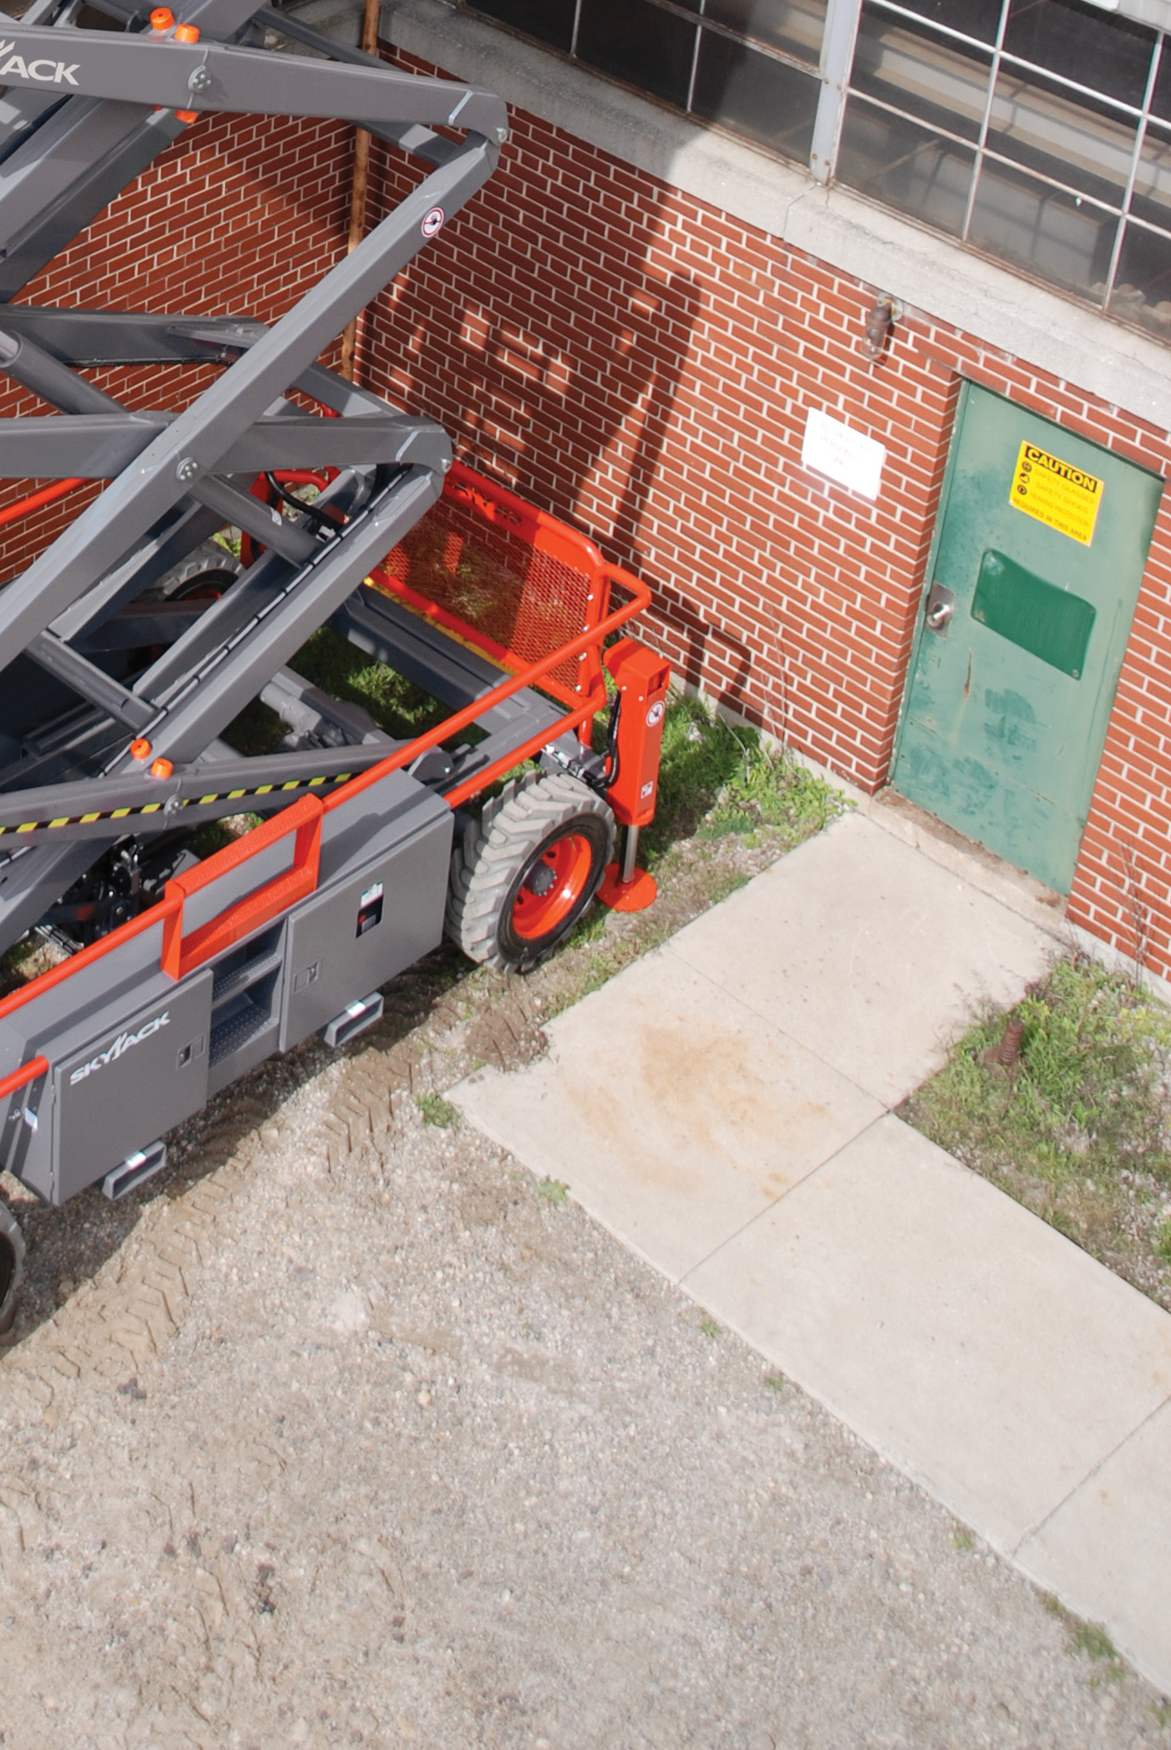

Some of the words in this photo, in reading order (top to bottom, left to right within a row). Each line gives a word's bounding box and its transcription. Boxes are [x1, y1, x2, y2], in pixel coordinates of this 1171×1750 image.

[1027, 448, 1096, 492] CAUTION
[1034, 469, 1060, 487] SAFETY
[1036, 482, 1062, 499] SAFETY
[1013, 497, 1045, 519] REQUIRED
[70, 1011, 171, 1086] SKYJACK
